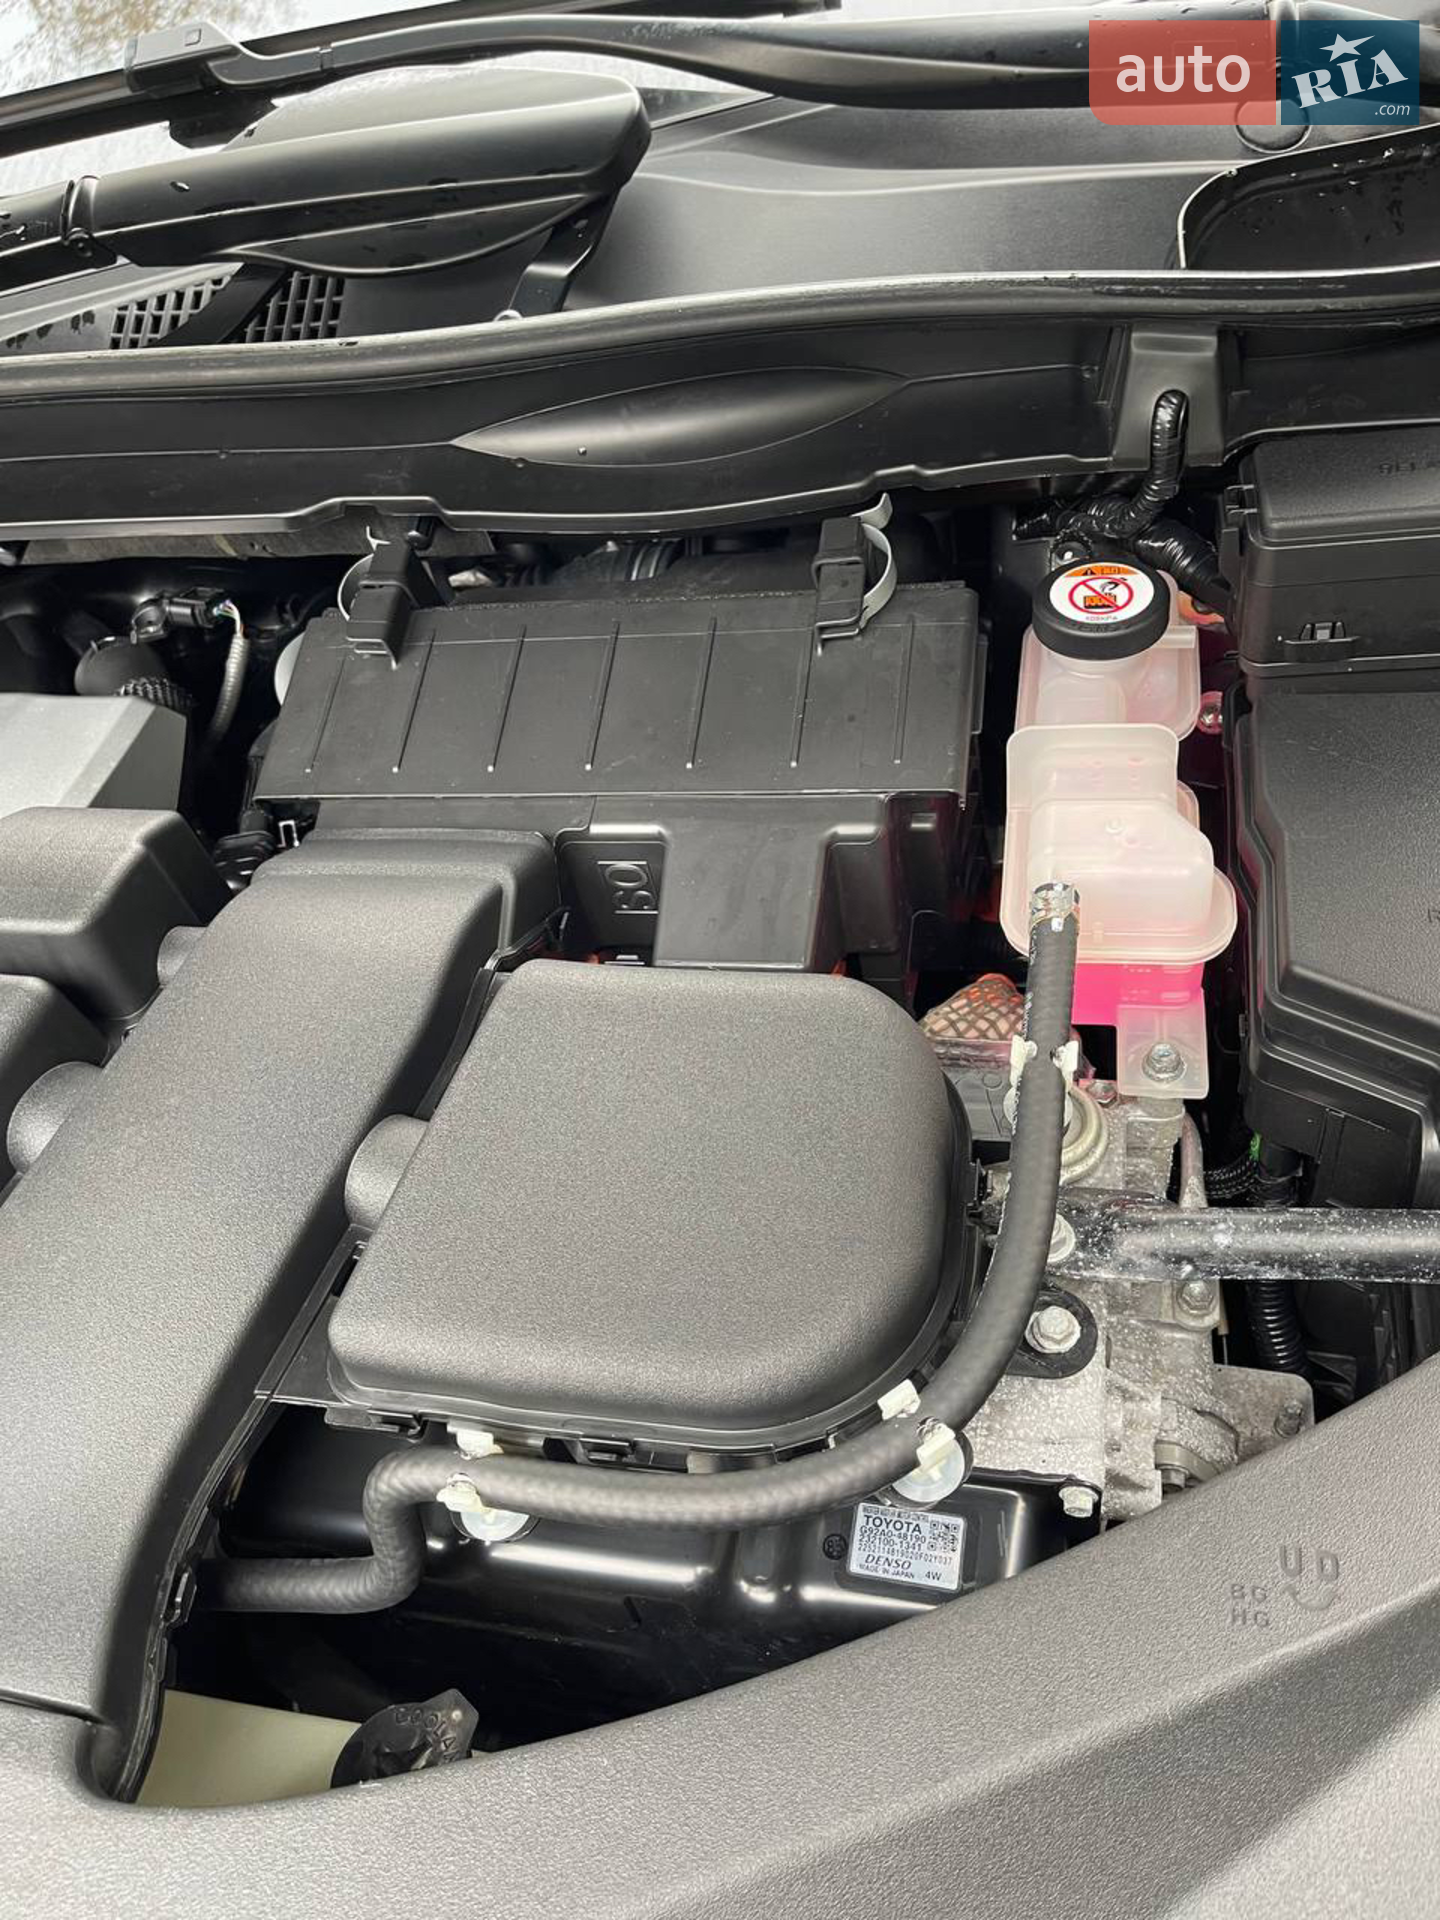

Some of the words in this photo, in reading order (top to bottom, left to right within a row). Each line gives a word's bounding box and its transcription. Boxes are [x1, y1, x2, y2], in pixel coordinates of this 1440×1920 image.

[863, 1514, 922, 1535] TOYOTA
[858, 1534, 922, 1552] 232100-1341
[859, 1526, 927, 1544] G92A0-48190
[864, 1553, 912, 1571] DENSO
[891, 1568, 915, 1579] JAPAN
[924, 1570, 942, 1582] 4W
